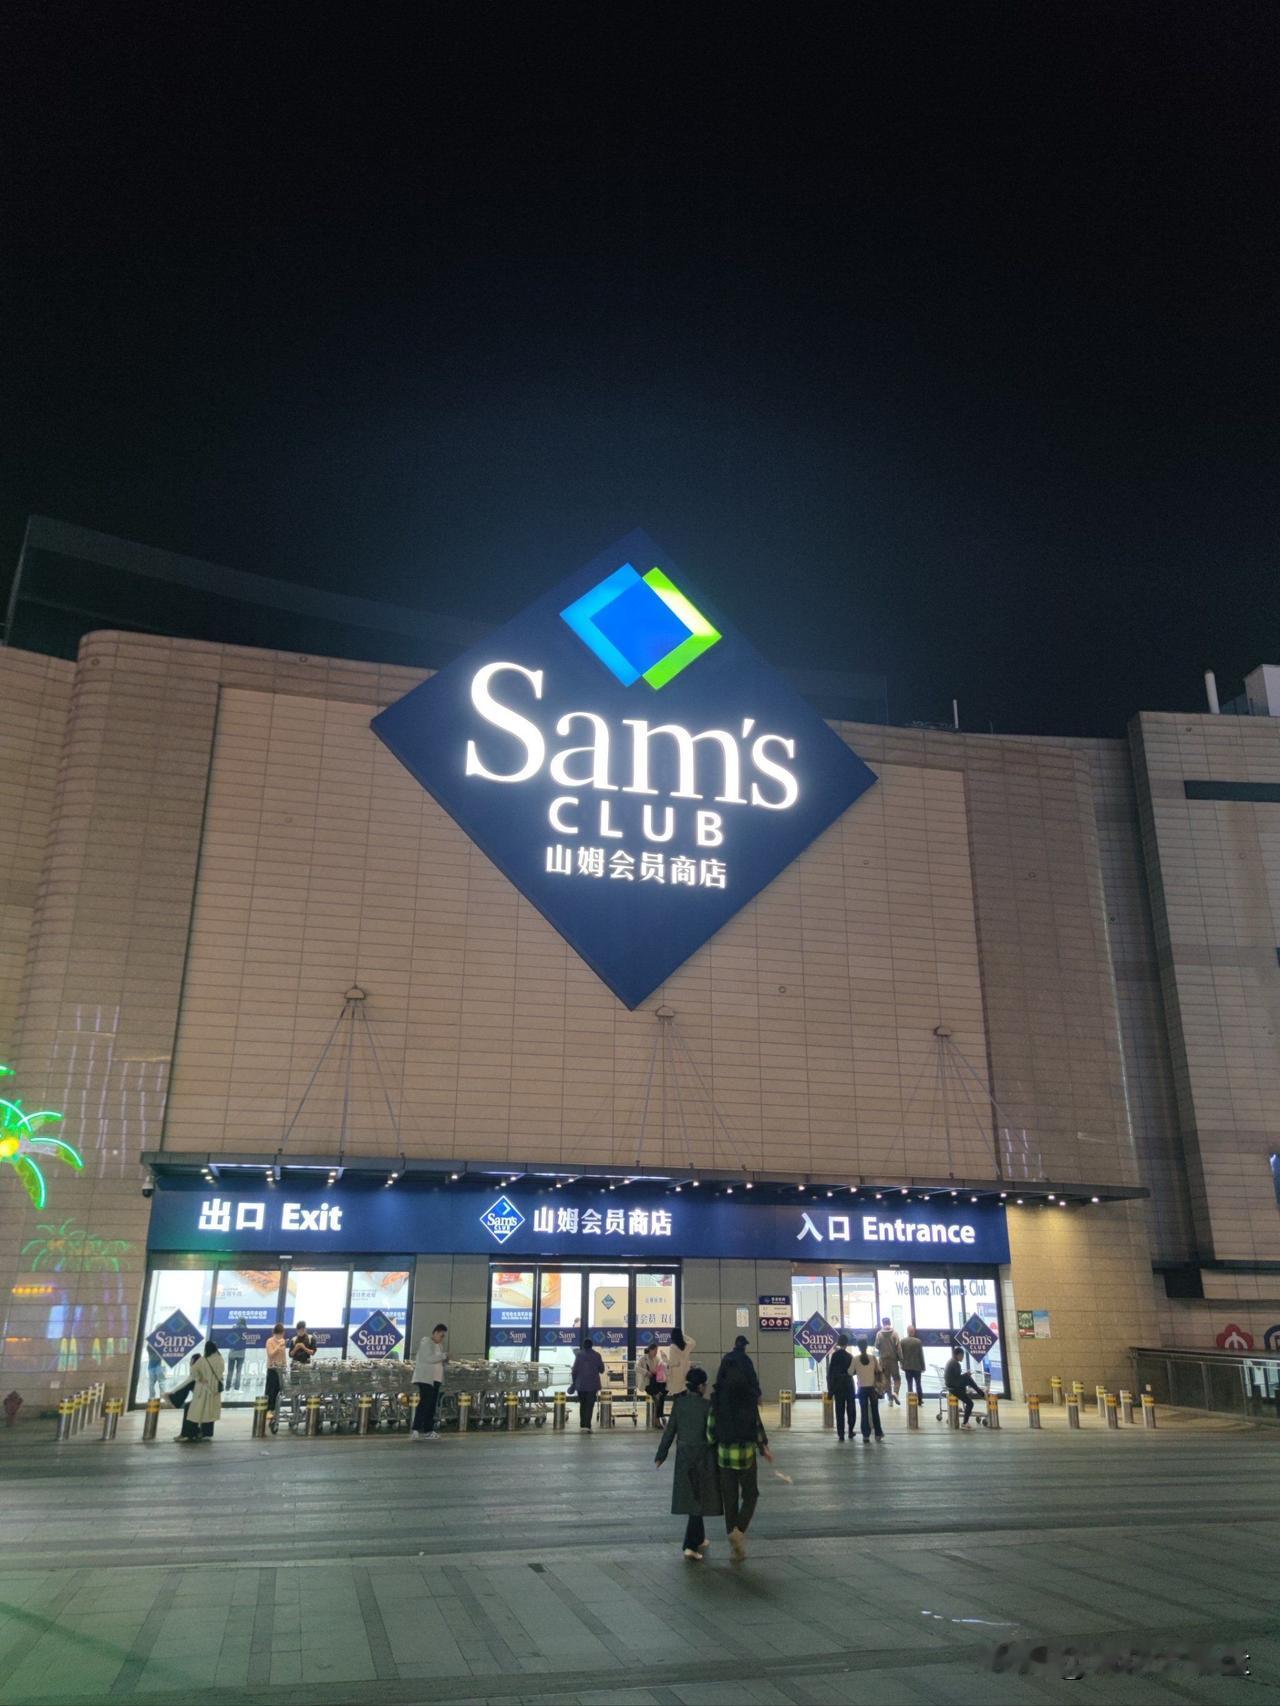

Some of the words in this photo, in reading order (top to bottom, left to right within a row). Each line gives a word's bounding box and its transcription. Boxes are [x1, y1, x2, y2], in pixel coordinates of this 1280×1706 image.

[465, 661, 798, 810] Sam's
[548, 796, 724, 847] CLUB
[545, 844, 727, 889] 山姆会员商店
[198, 1198, 266, 1232] 出口
[281, 1202, 344, 1231] Exit
[487, 1213, 518, 1226] Sam's
[533, 1207, 673, 1236] 山姆会员商店
[796, 1212, 850, 1242] 入口
[862, 1216, 976, 1244] Entrance
[931, 1280, 941, 1296] To
[154, 1330, 195, 1347] Sam's
[358, 1330, 396, 1346] Sam's
[801, 1330, 834, 1345] Sam's
[961, 1331, 992, 1346] Sam's
